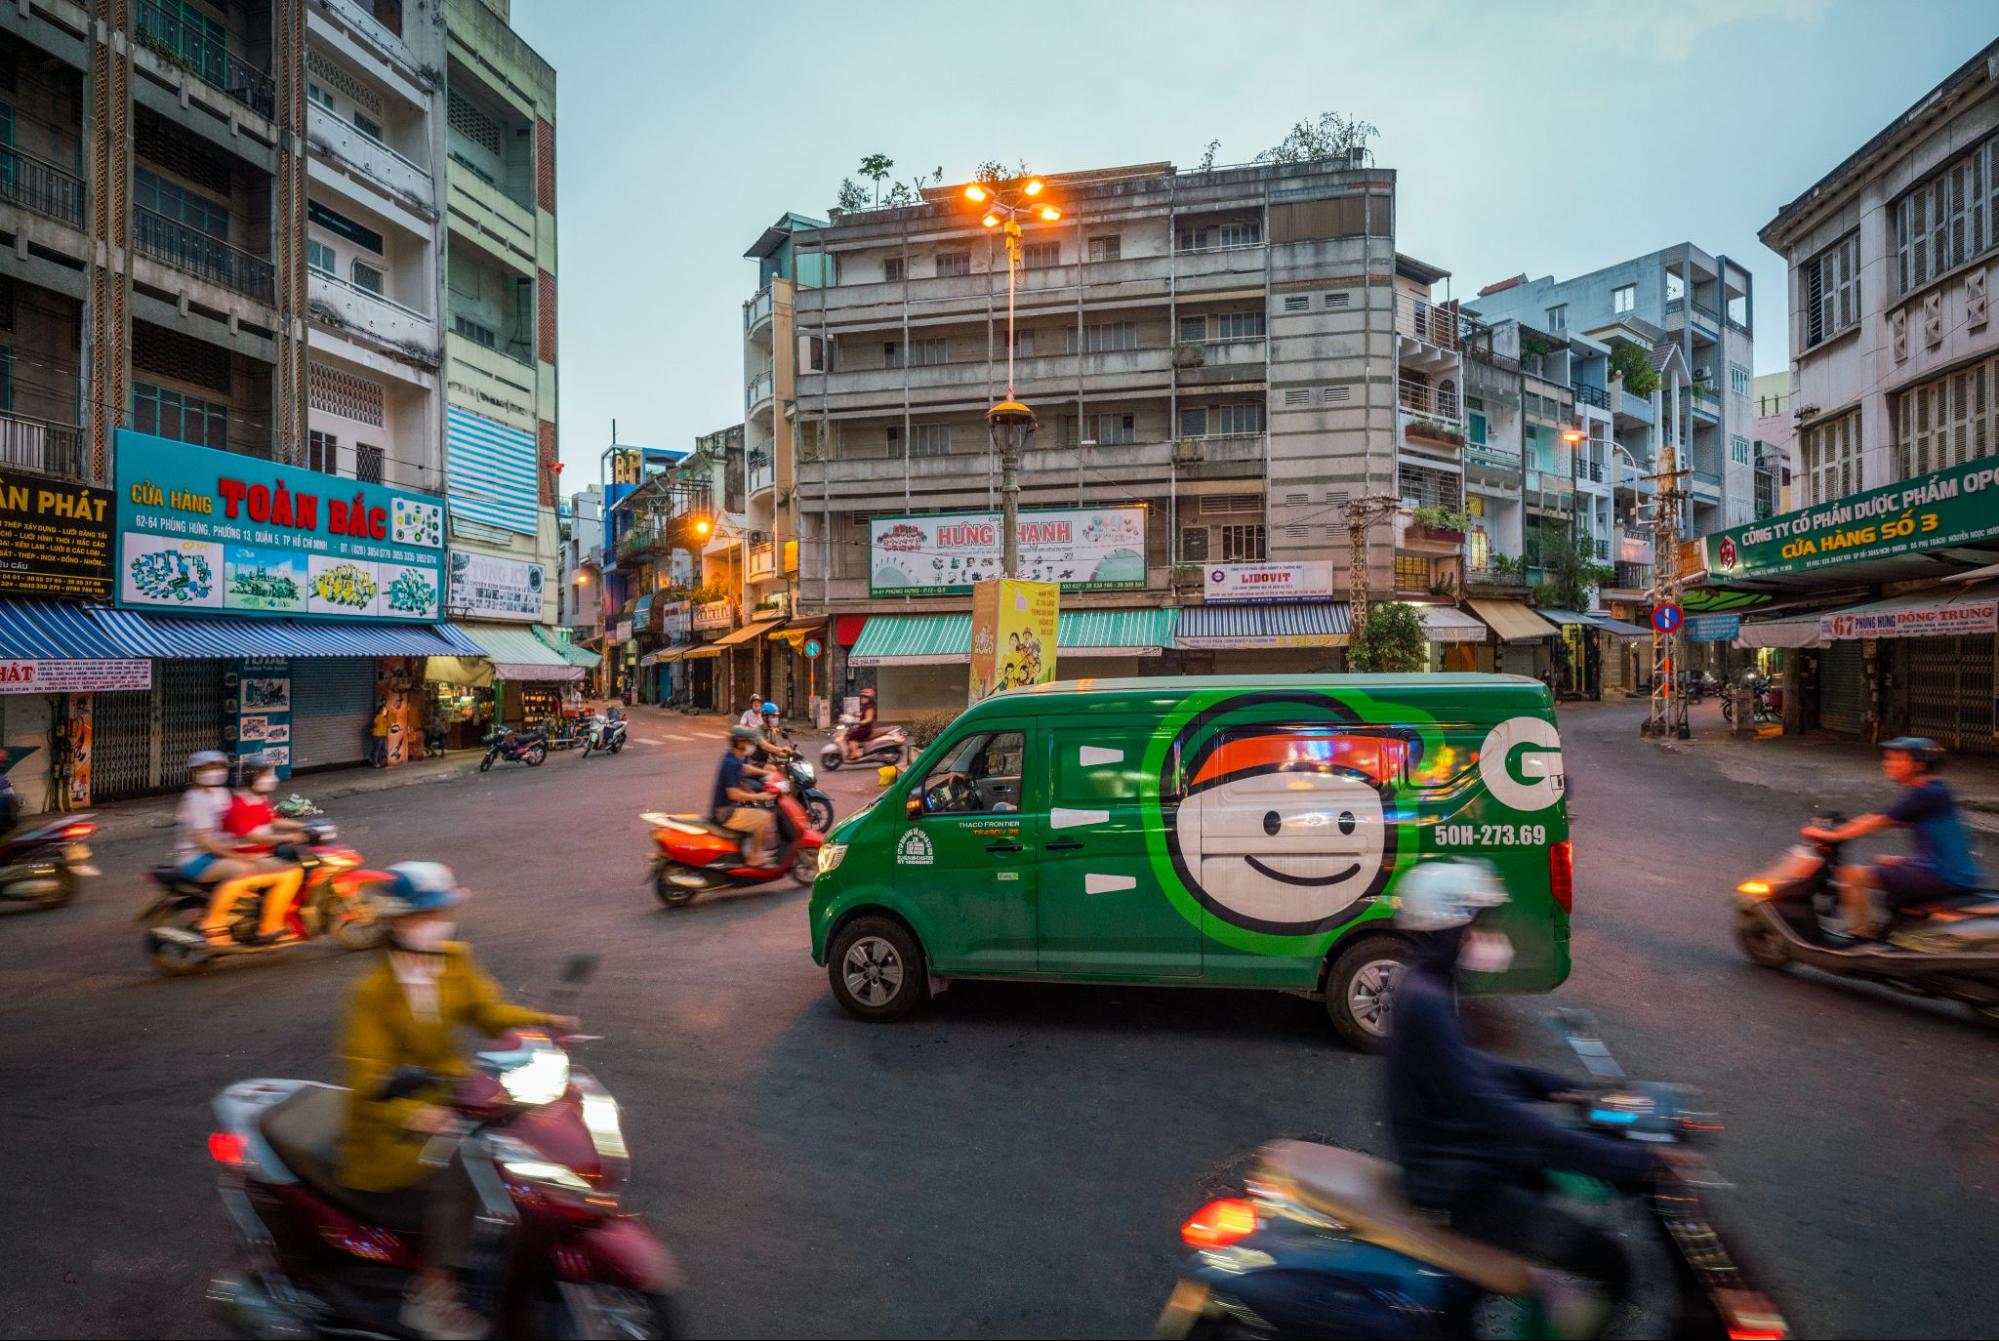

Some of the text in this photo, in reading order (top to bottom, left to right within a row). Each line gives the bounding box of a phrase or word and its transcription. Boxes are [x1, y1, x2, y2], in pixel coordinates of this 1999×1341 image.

[38, 489, 107, 522] PHÁT
[131, 480, 212, 514] CỬA HÀNG
[218, 476, 388, 540] TOÀN BẮC
[1741, 526, 1773, 546] CÔNG
[1773, 521, 1790, 538] TY
[1792, 510, 1811, 534] CỔ
[1813, 502, 1852, 530] PHẦN
[1854, 493, 1900, 519] DƯỢC
[1902, 474, 1959, 508] PHẨM
[135, 514, 157, 528] 62-64
[160, 516, 186, 533] PHÙNG
[213, 523, 241, 540] PHƯỜNG
[255, 530, 273, 545] QUẬN
[283, 535, 291, 546] TP
[292, 533, 302, 548] HỒ
[937, 521, 995, 548] HƯNG
[1781, 508, 1939, 559] CỬA HÀNG SỐ 3
[1832, 615, 1855, 636] 67
[1939, 607, 1994, 620] TRUNG
[1435, 825, 1546, 846] 50H-273.69
